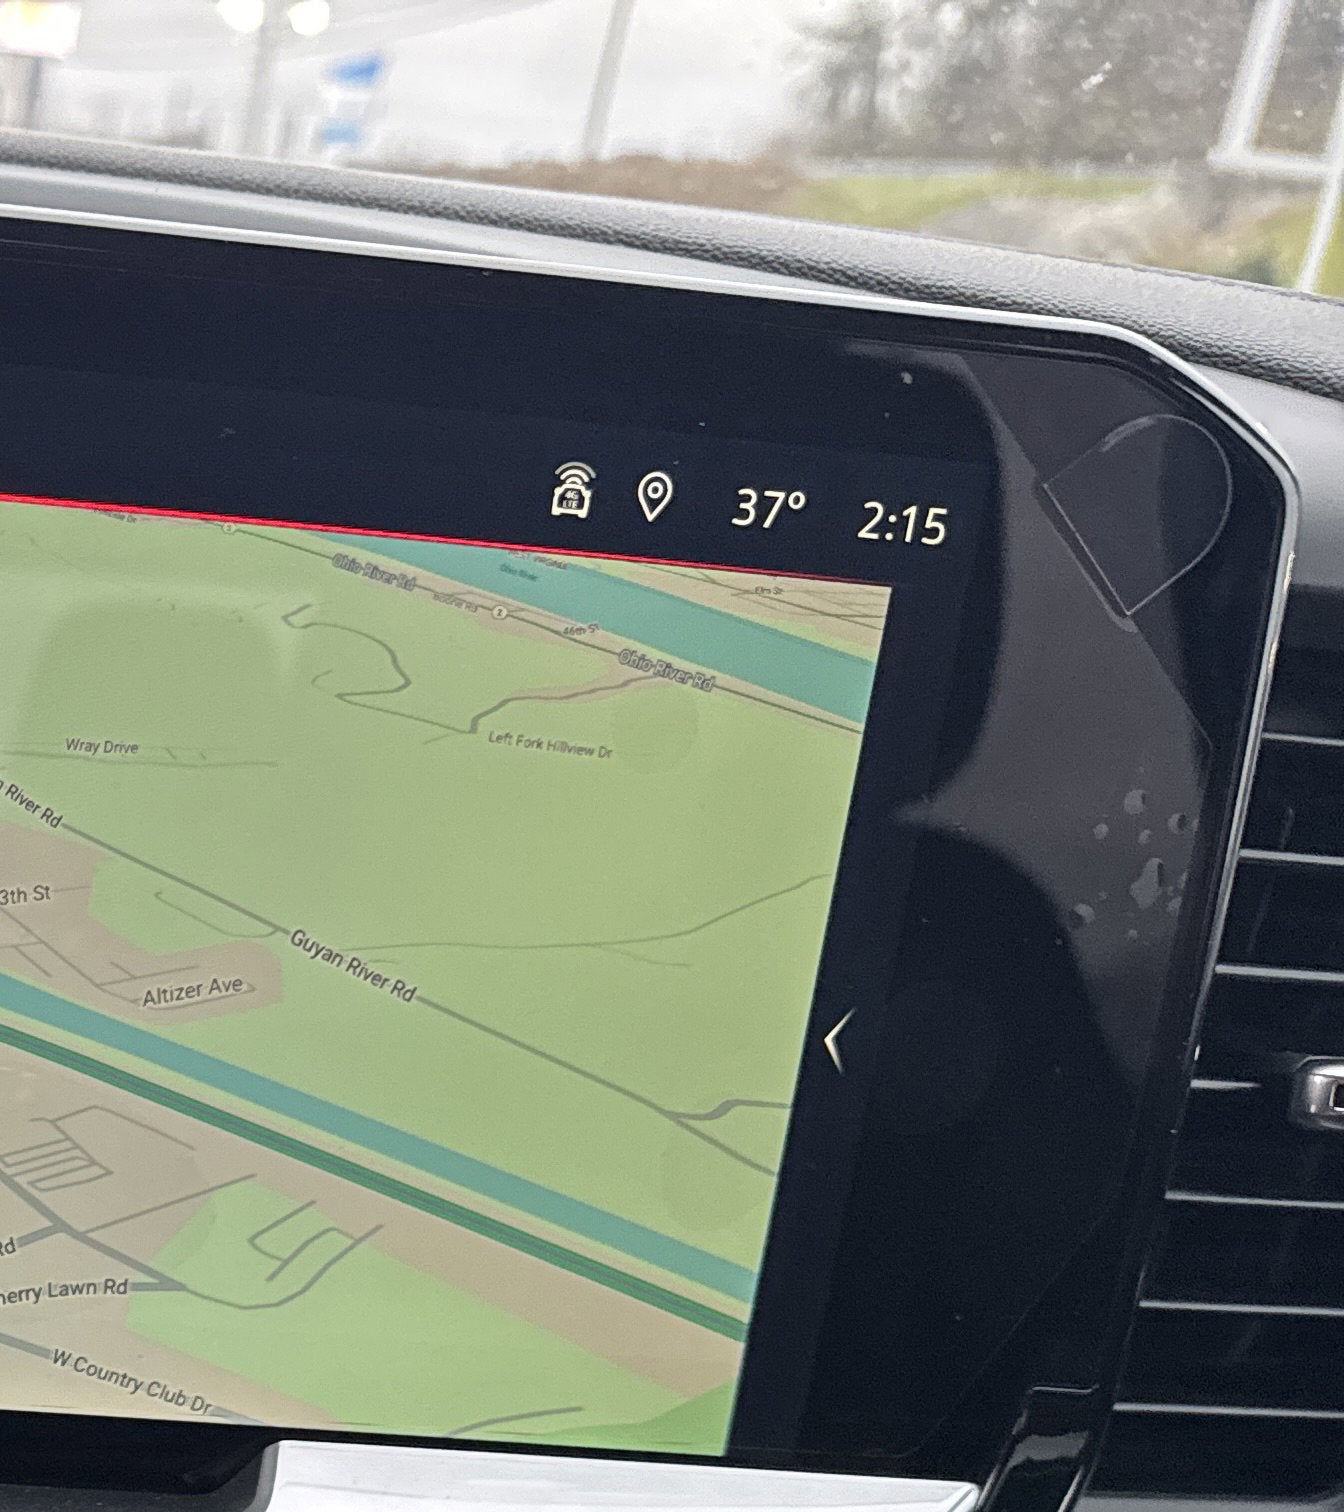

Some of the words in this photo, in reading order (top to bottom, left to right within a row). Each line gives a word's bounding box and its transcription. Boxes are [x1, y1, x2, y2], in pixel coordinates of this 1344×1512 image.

[731, 488, 806, 528] 37°
[857, 501, 947, 545] 2:15
[618, 648, 653, 673] Ohio
[653, 659, 692, 686] River
[692, 672, 714, 691] Rd
[65, 736, 100, 756] Wray
[103, 740, 139, 755] Drive
[488, 730, 513, 746] Left
[515, 734, 544, 751] Fork
[547, 740, 595, 758] Hillview
[598, 747, 612, 759] Dr
[4, 782, 45, 816] River
[40, 804, 64, 829] Rd
[31, 884, 52, 902] St
[289, 928, 345, 969] Guyan
[345, 956, 395, 992] River
[389, 976, 418, 1004] Rd
[141, 982, 204, 1008] Altizer
[207, 976, 244, 996] Ave
[47, 1280, 98, 1299] Lawn
[103, 1277, 129, 1295] Rd
[51, 1348, 74, 1367] W
[73, 1356, 144, 1395] Country
[146, 1381, 187, 1408] Club
[190, 1394, 215, 1416] Dr
